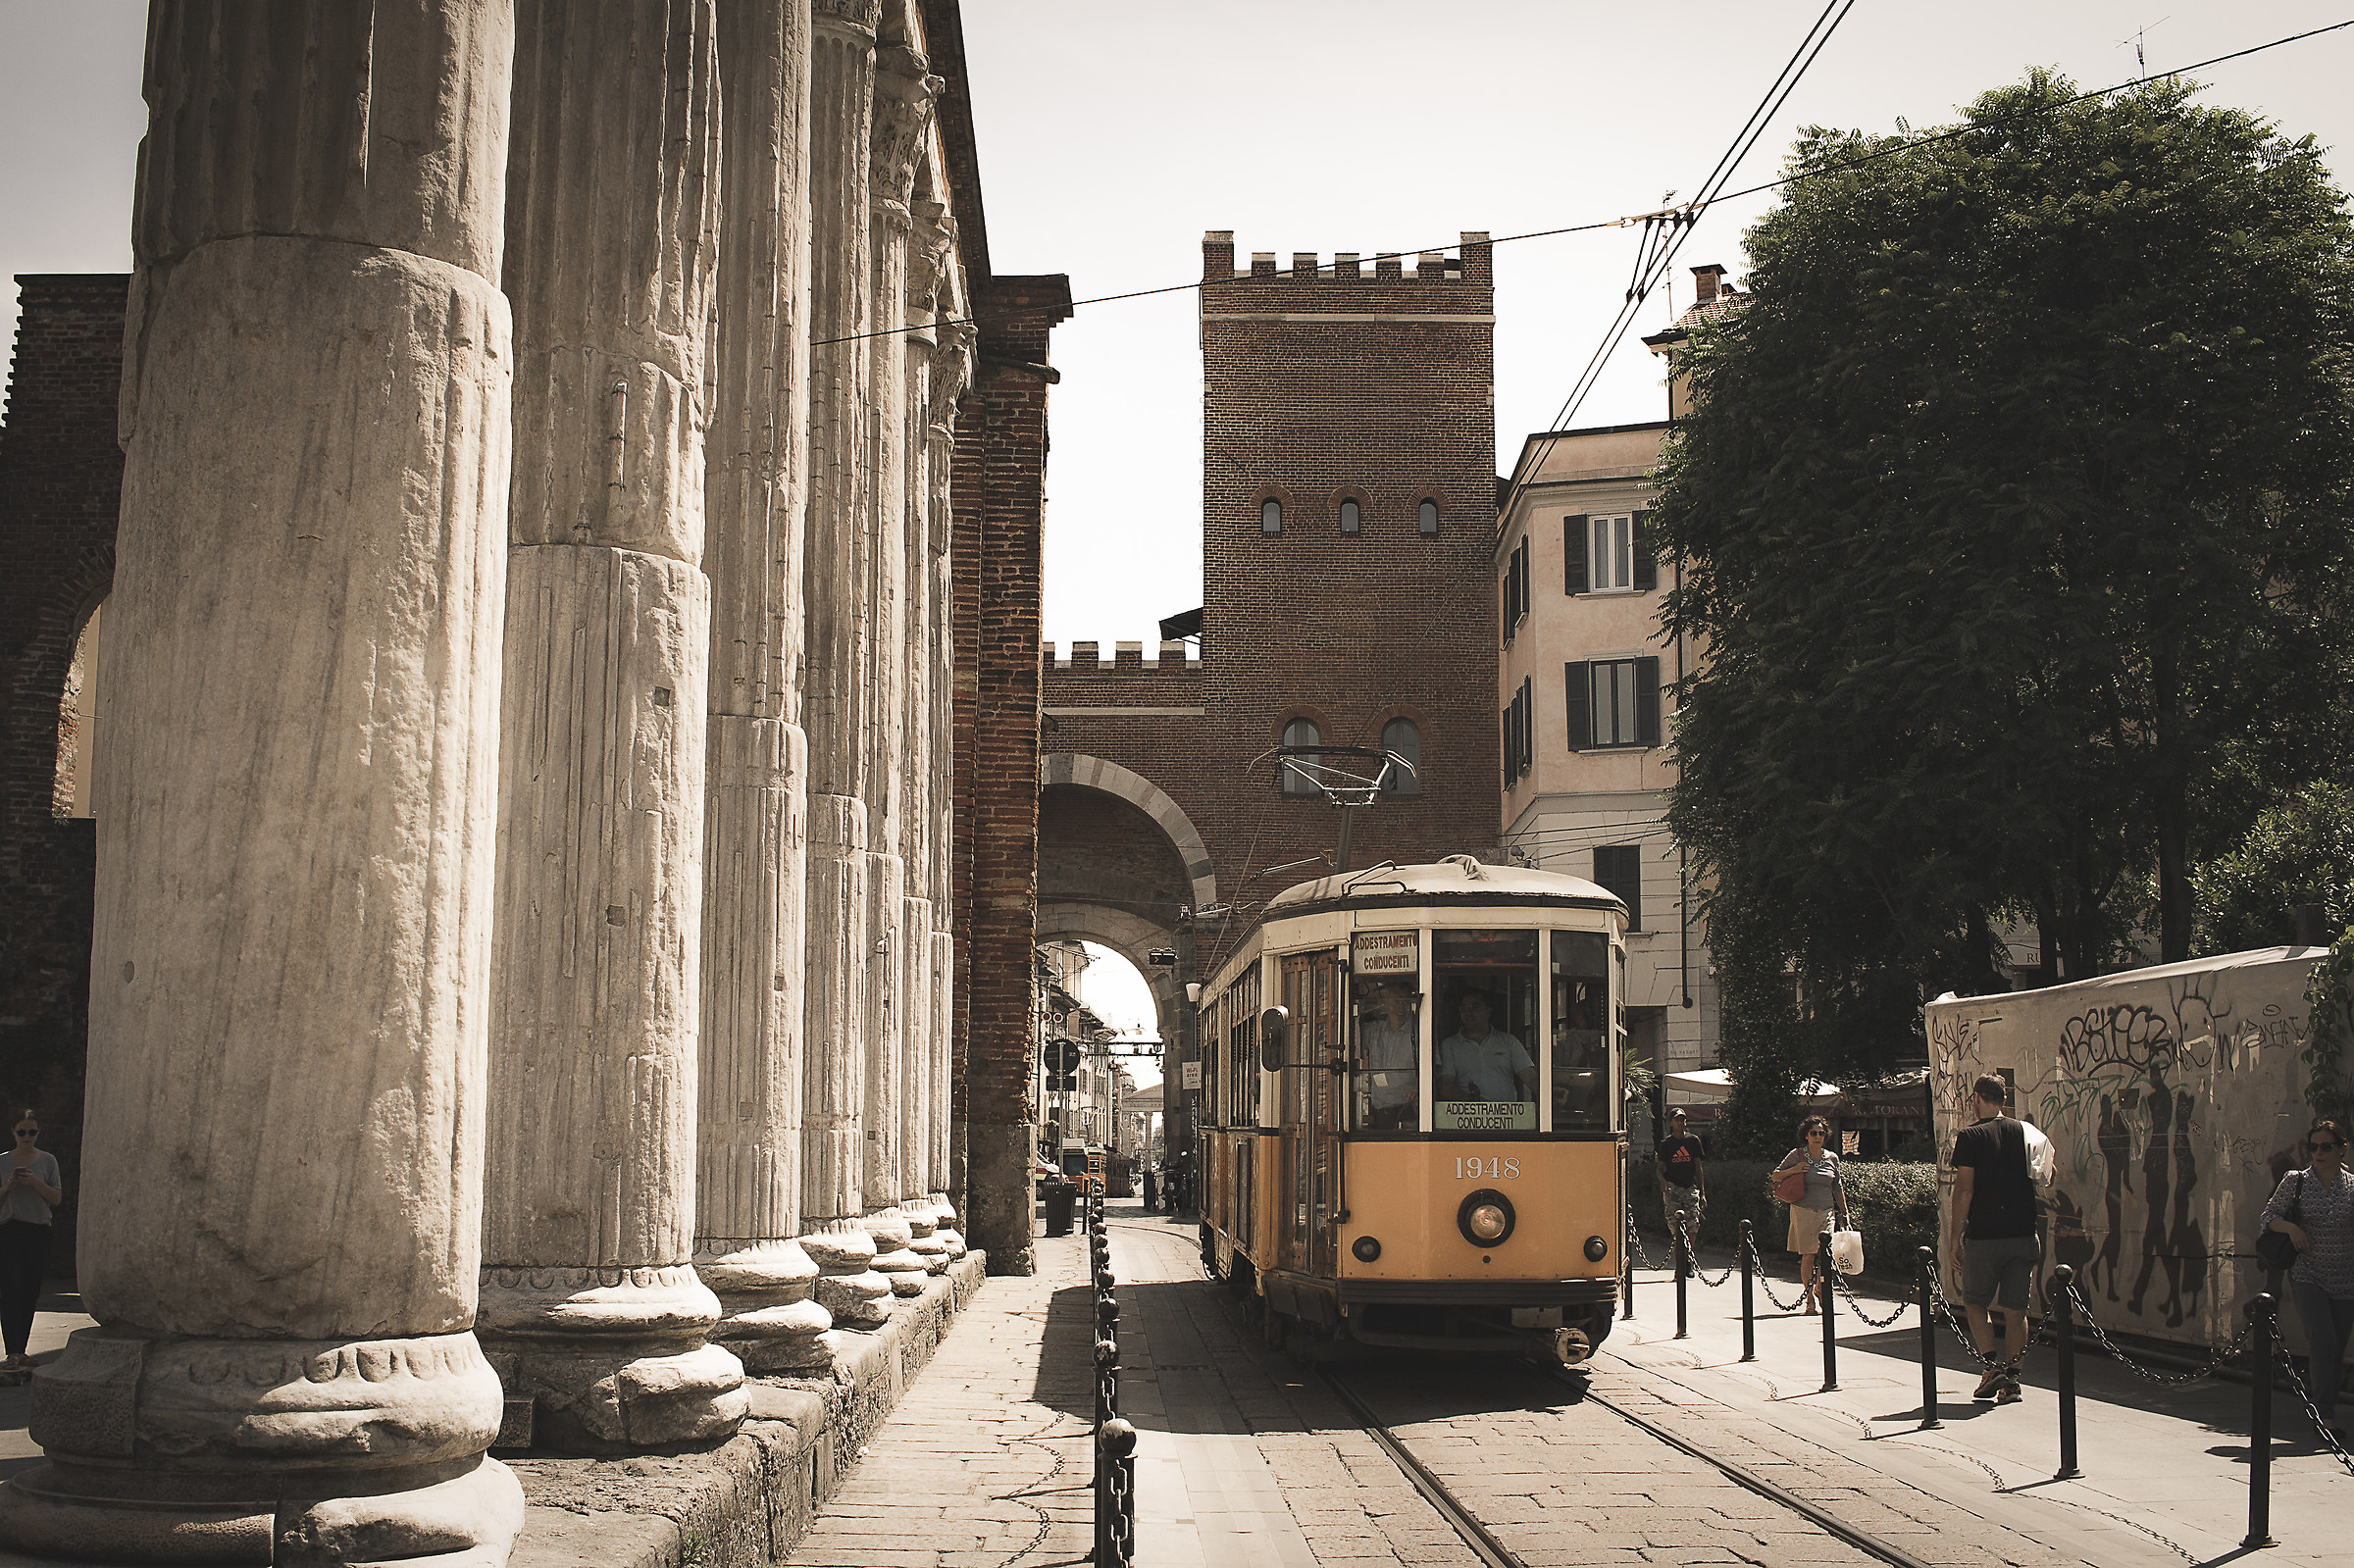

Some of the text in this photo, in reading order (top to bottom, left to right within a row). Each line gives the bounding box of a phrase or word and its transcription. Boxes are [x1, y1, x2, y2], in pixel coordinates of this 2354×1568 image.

[1355, 934, 1418, 950] ADDESTRAMENTO
[1364, 955, 1409, 970] CONDUCENTI
[1446, 1103, 1525, 1116] ADDESTRAMENTO
[1457, 1117, 1513, 1129] CONDUCENTI
[1456, 1156, 1521, 1180] 1948
